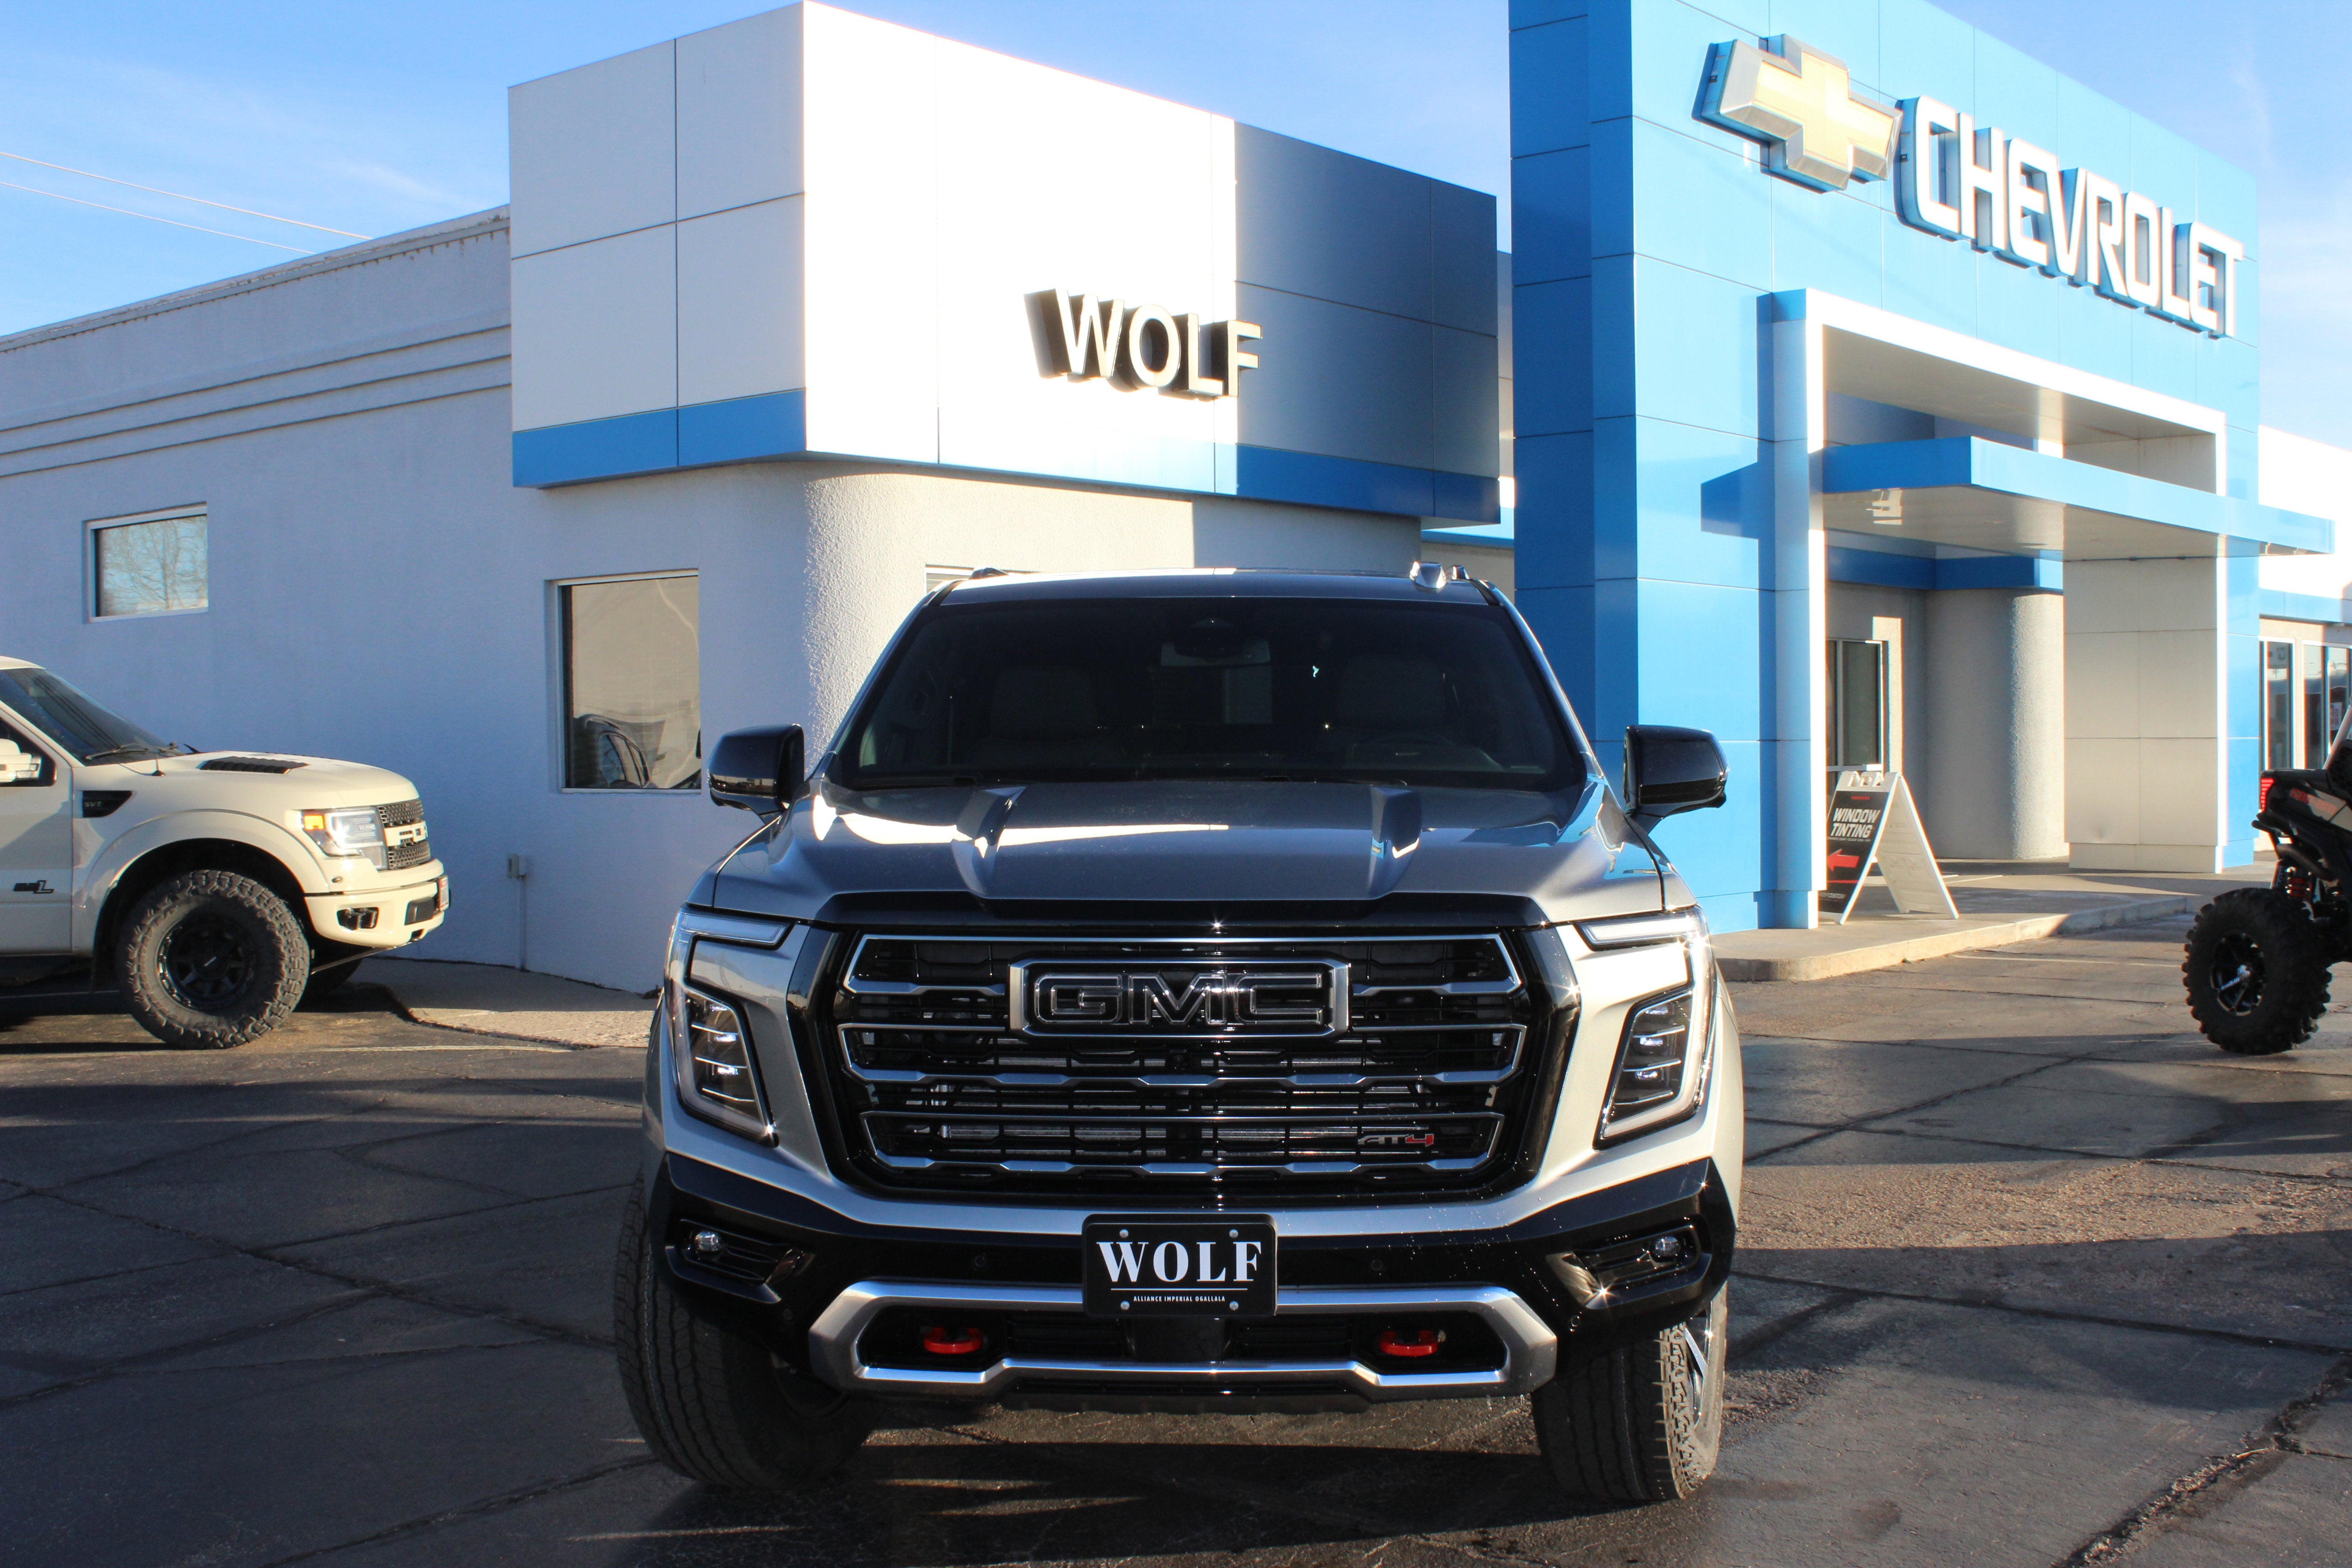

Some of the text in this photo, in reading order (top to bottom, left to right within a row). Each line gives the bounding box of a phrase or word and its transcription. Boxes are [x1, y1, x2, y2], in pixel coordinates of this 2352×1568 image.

[1900, 94, 2244, 339] CHEVROLET
[1032, 288, 1262, 400] WOLF
[1830, 823, 1873, 838] TINTING
[1833, 808, 1882, 823] WINDOW
[1034, 973, 1323, 1025] GMC
[1357, 1133, 1434, 1147] AT4
[1096, 1241, 1261, 1282] WOLF
